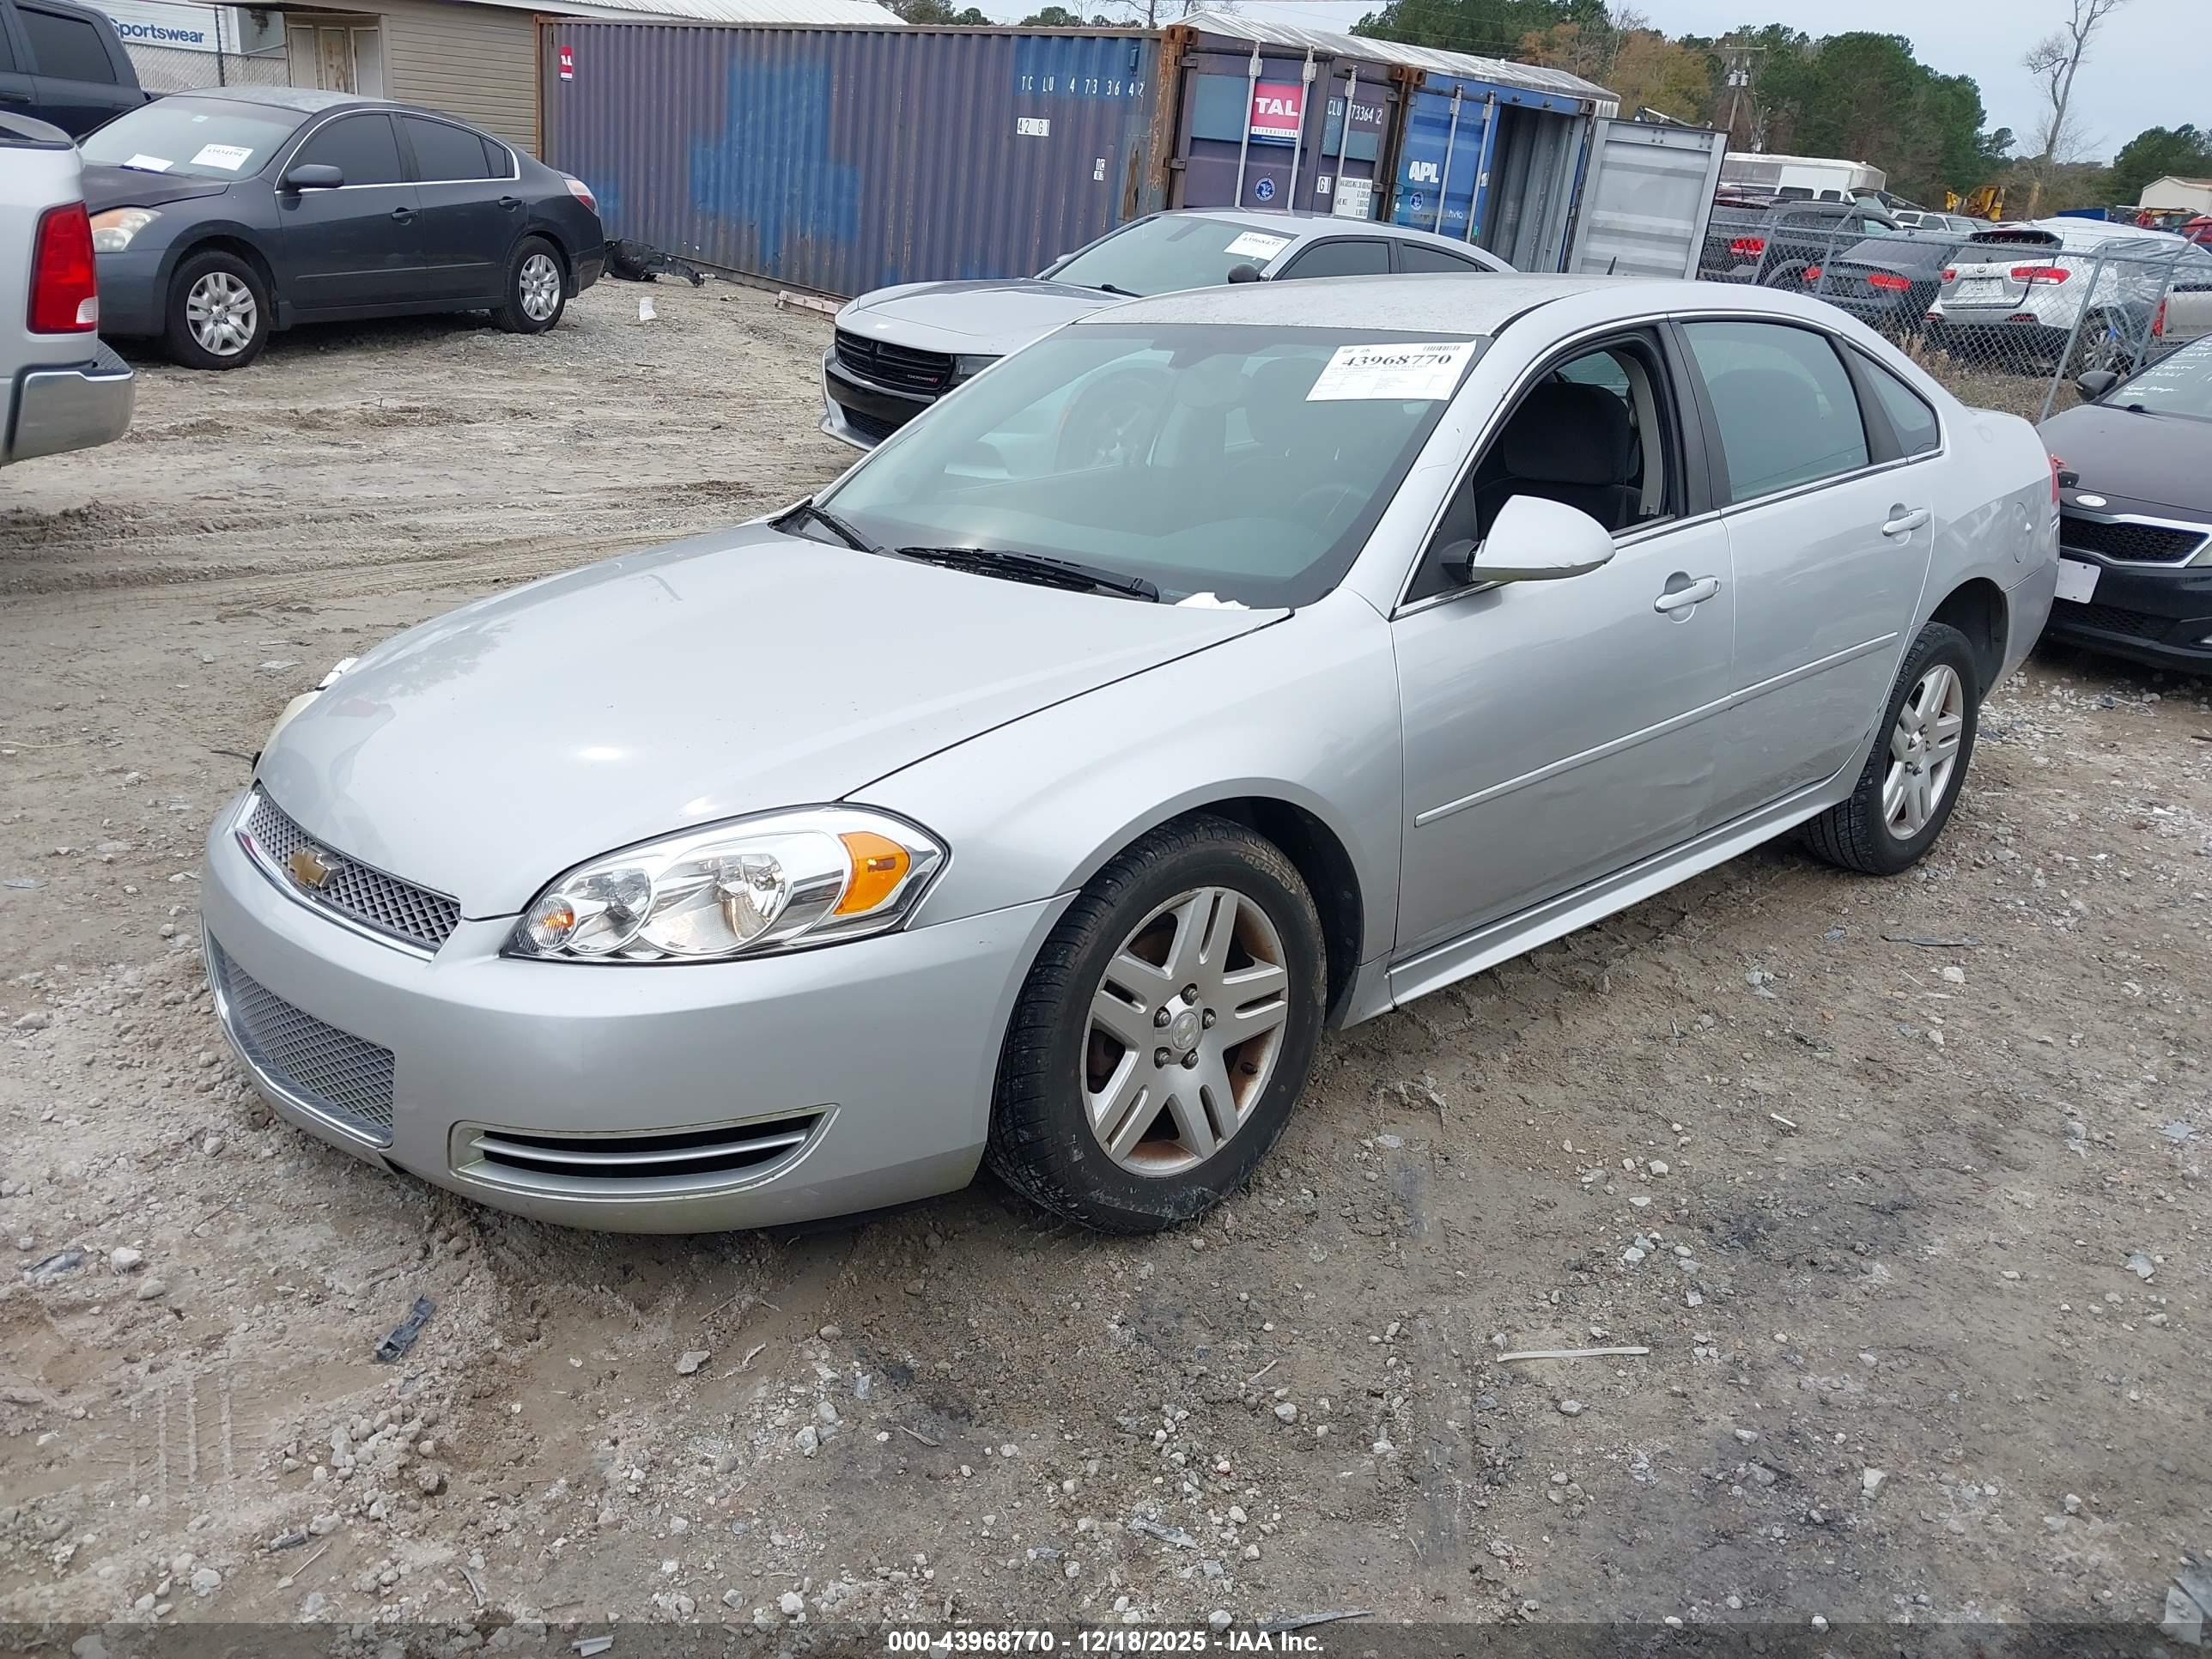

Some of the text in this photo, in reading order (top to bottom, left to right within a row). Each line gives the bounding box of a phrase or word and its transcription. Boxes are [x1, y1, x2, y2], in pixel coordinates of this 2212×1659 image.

[1255, 97, 1298, 117] TAL
[1408, 161, 1439, 184] APL
[1341, 354, 1452, 367] 43968770
